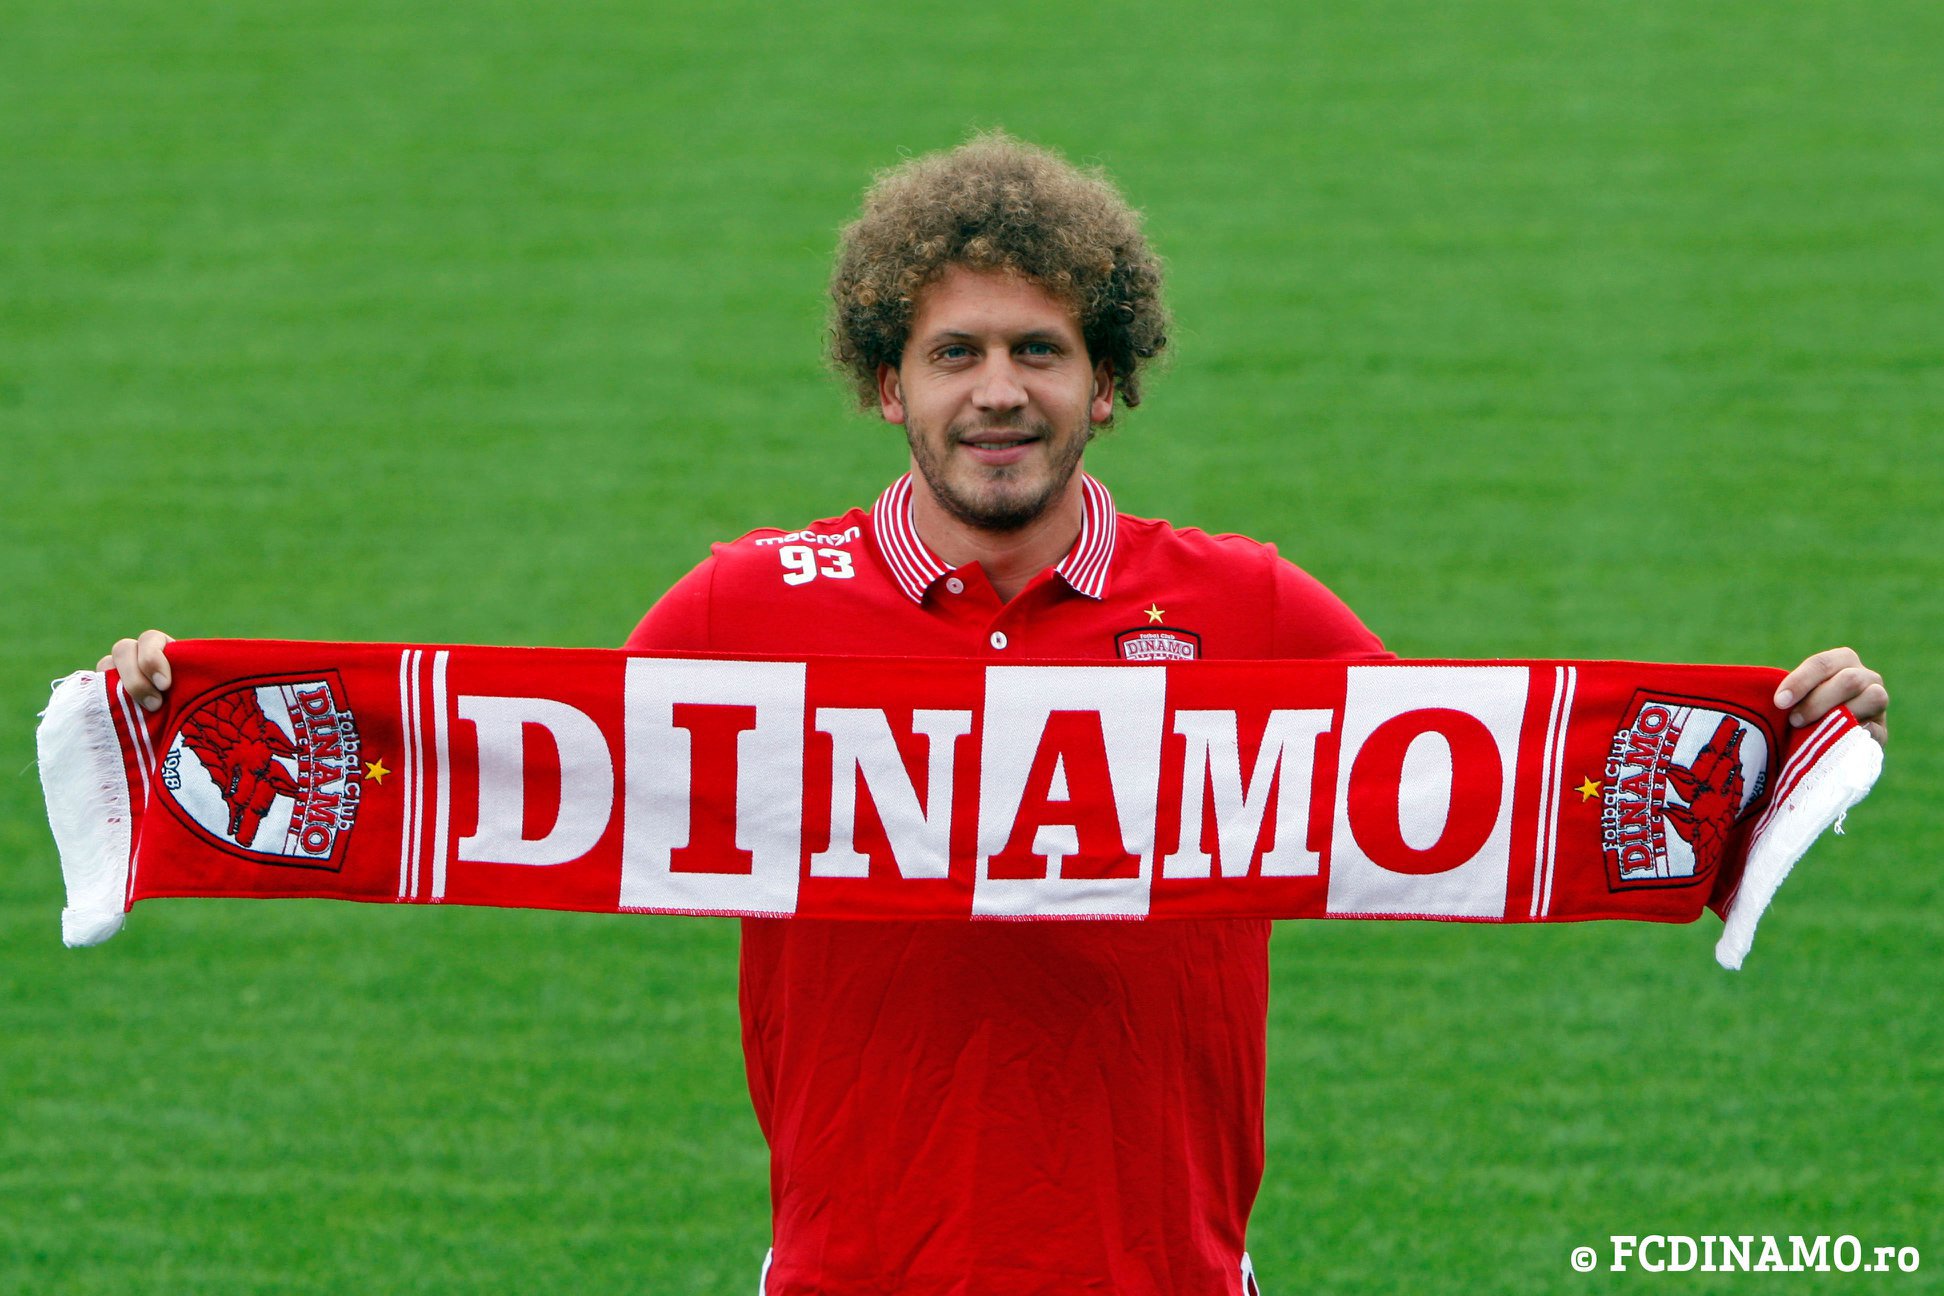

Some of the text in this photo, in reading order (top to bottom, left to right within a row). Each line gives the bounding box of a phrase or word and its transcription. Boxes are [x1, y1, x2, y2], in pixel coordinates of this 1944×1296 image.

[755, 526, 861, 547] macron
[779, 545, 855, 586] 93
[1126, 640, 1192, 656] DINAMO
[161, 748, 182, 790] 1948
[297, 686, 344, 855] DINAMO
[337, 710, 362, 831] Fotbal Club
[457, 694, 1503, 881] DINAMO
[1602, 729, 1631, 852] Fotbal Club
[1618, 705, 1672, 874] DINAMO
